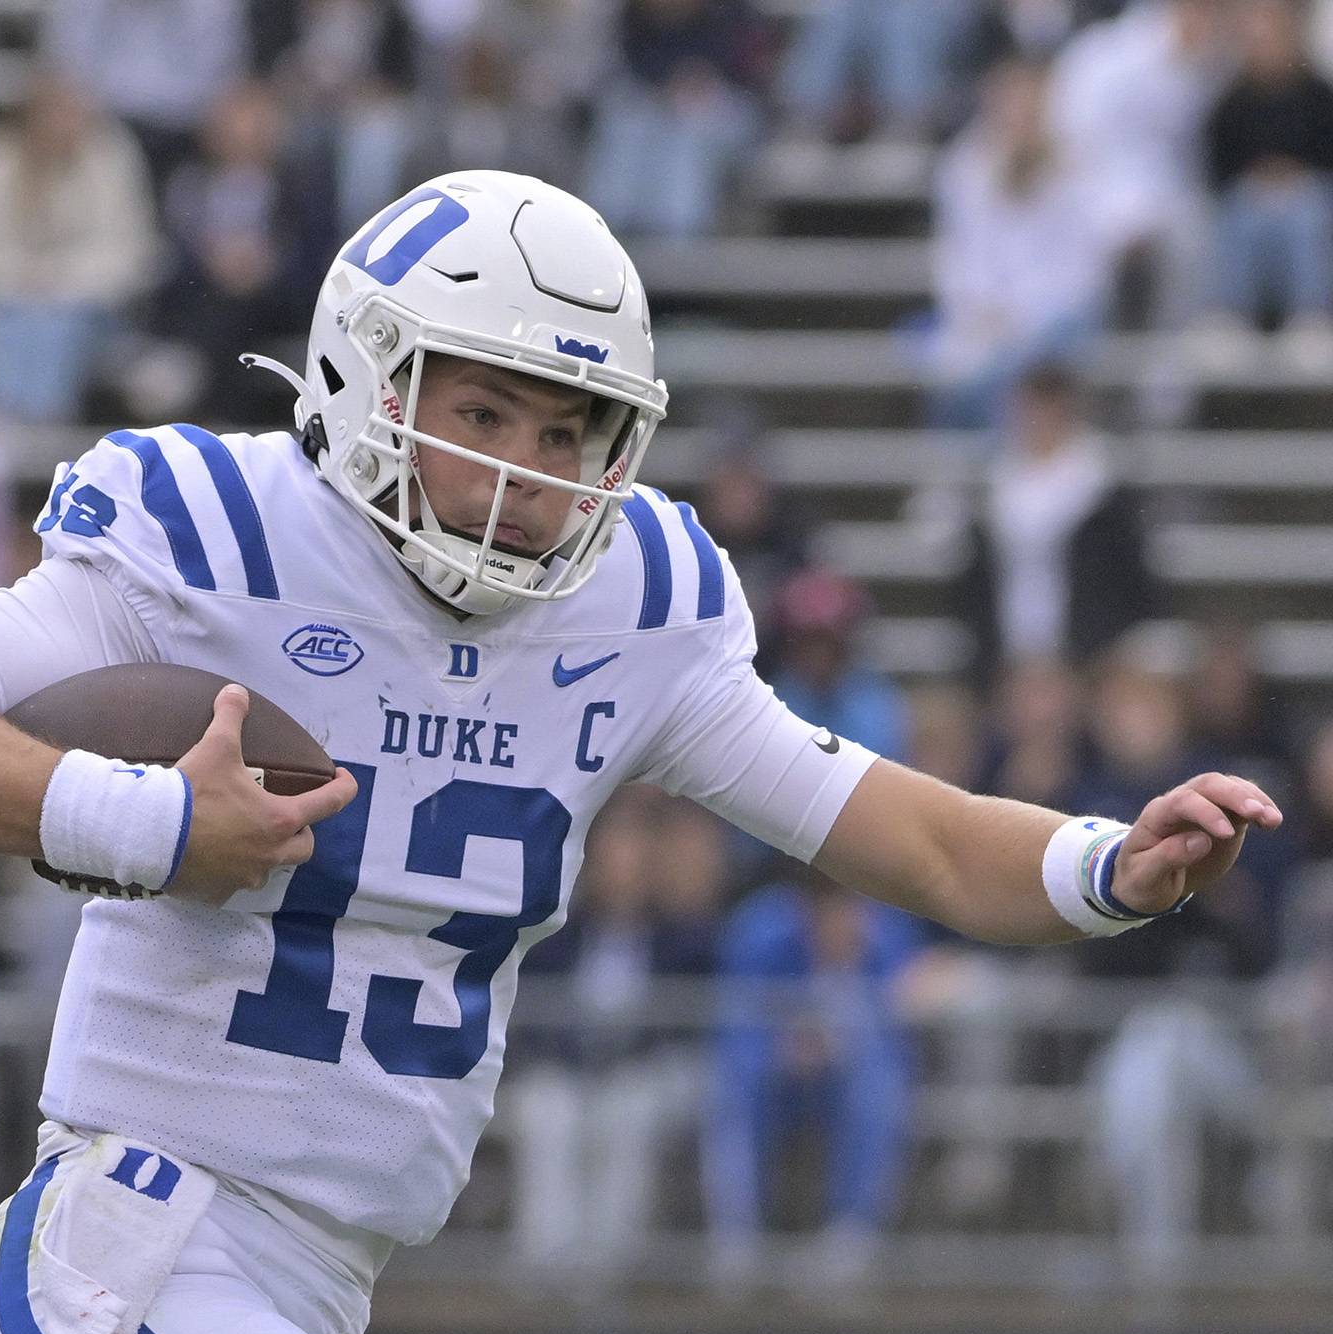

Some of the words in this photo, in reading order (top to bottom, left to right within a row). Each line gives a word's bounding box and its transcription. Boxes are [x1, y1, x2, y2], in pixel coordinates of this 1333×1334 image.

[339, 187, 470, 287] D
[576, 459, 626, 516] Ridell
[448, 643, 479, 678] D
[380, 708, 519, 769] DUKE
[575, 700, 617, 773] C
[226, 758, 573, 1080] 13
